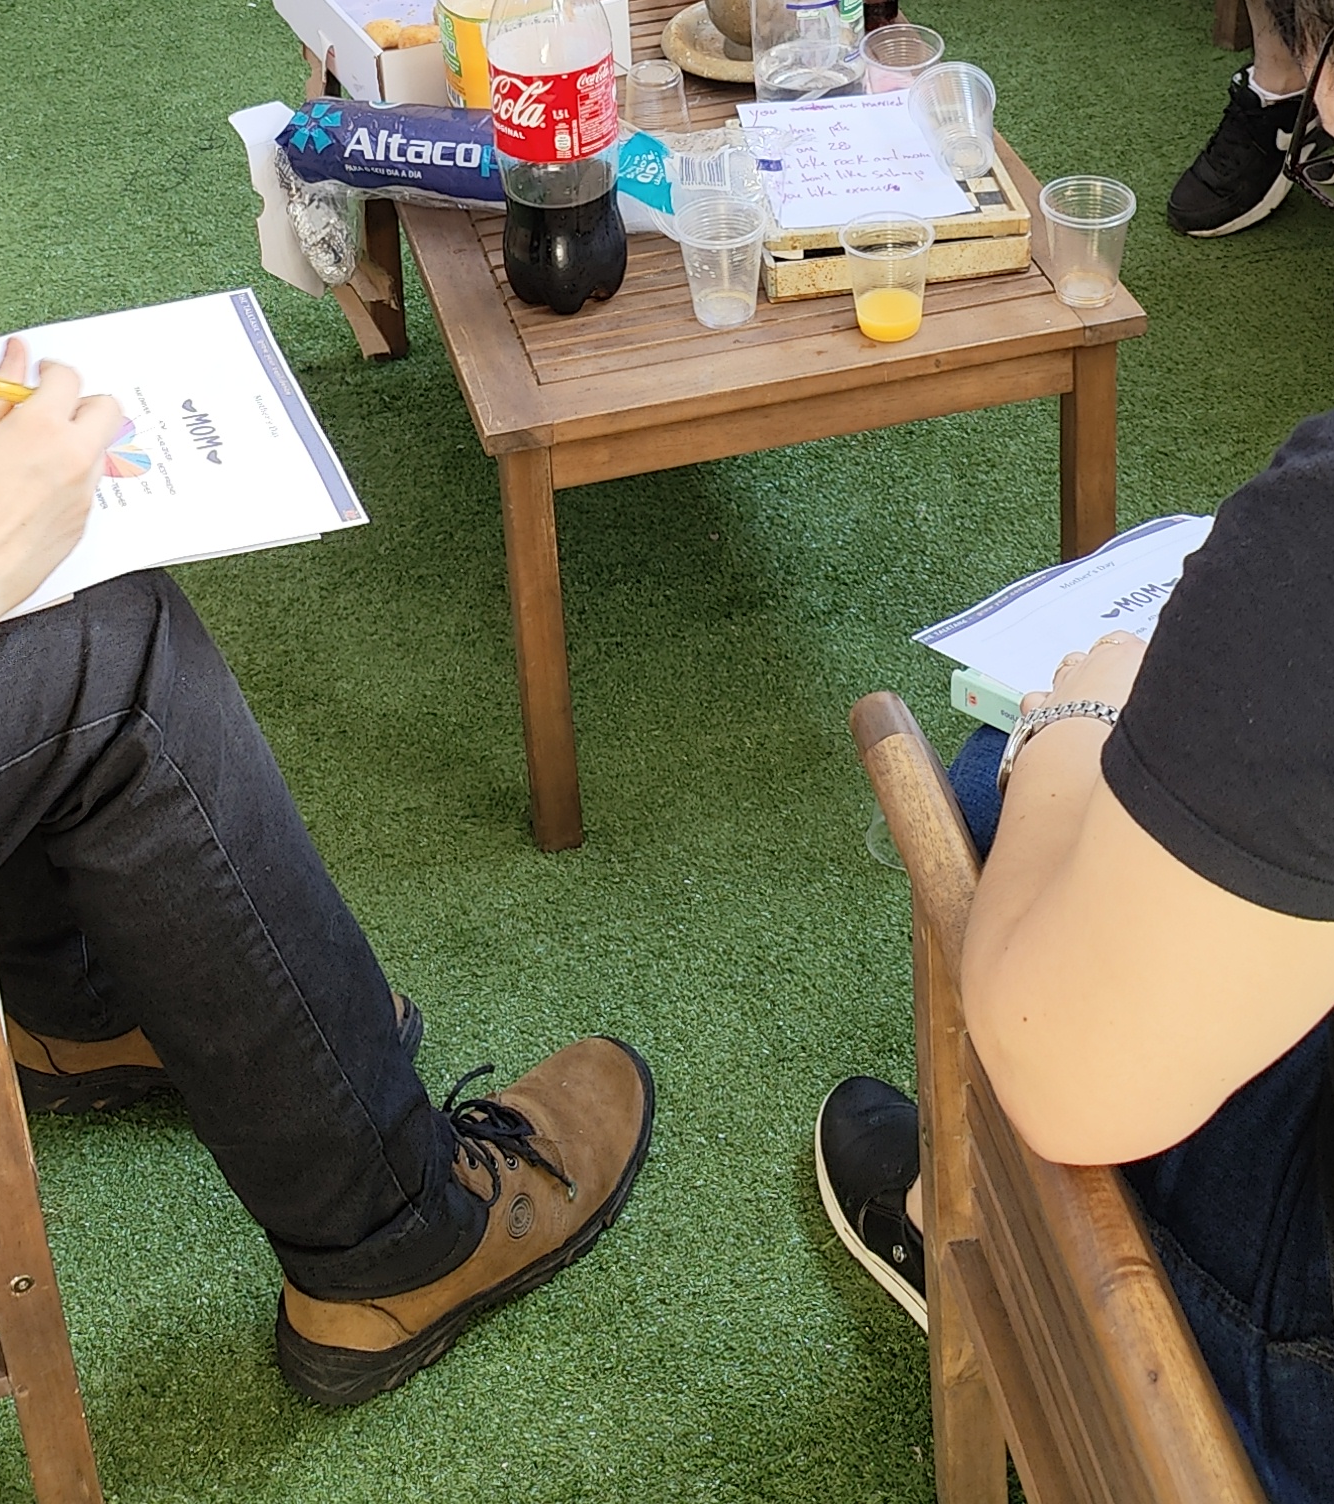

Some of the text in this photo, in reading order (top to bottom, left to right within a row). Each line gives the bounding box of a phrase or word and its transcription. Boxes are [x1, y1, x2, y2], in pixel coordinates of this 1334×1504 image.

[862, 97, 905, 108] married
[834, 155, 867, 165] rock
[386, 168, 400, 177] DIA
[400, 170, 407, 178] A
[408, 170, 422, 179] DIA
[181, 412, 223, 451] MOM
[1059, 560, 1116, 591] Mother's Day
[1114, 583, 1163, 613] MOM
